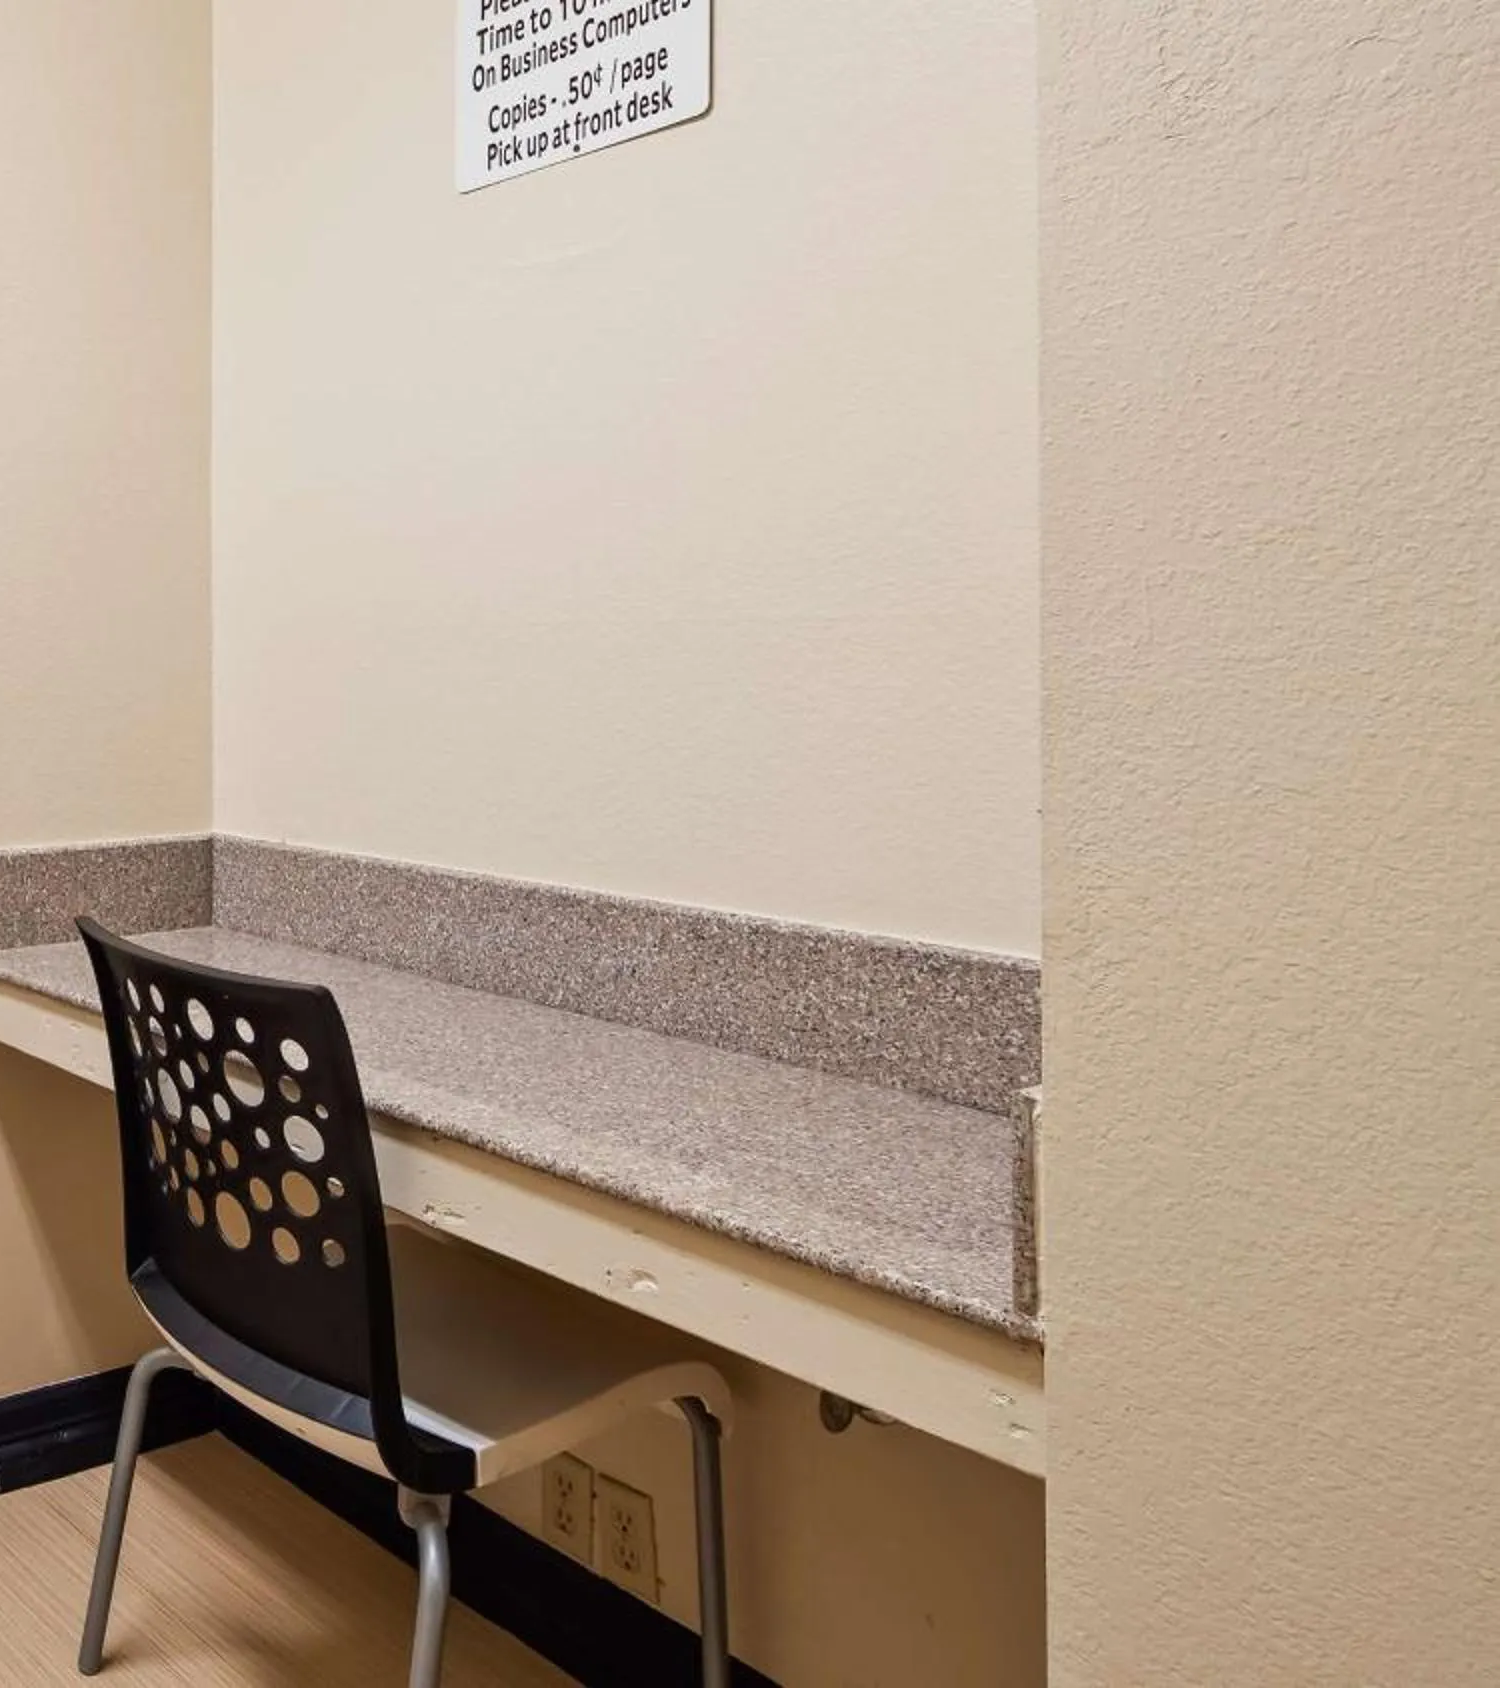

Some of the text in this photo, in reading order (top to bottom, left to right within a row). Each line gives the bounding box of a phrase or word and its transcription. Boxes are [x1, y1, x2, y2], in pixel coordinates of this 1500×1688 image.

[476, 19, 525, 55] Time
[529, 8, 552, 34] to
[480, 0, 530, 21] Ple
[472, 64, 496, 92] On
[501, 32, 578, 82] Business
[489, 94, 547, 133] Copies
[621, 47, 668, 90] page
[487, 80, 673, 171] Pick up at front desk
